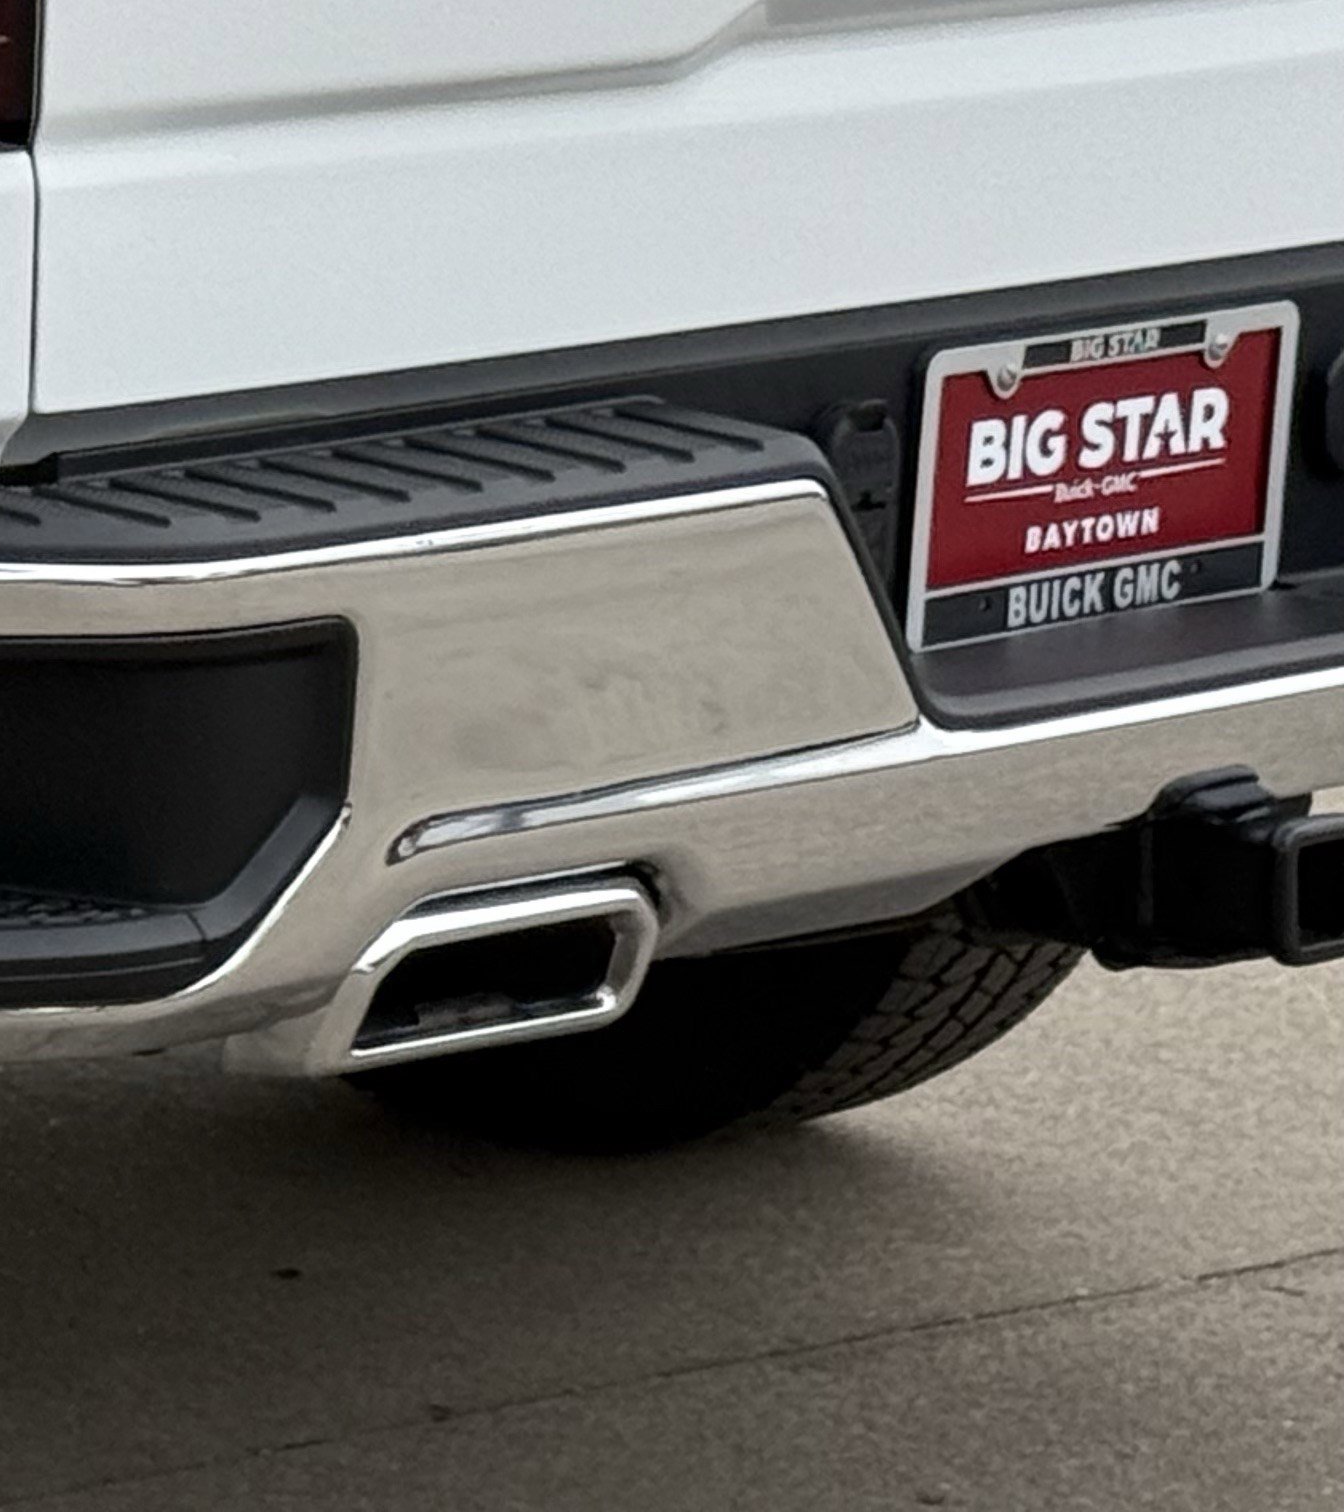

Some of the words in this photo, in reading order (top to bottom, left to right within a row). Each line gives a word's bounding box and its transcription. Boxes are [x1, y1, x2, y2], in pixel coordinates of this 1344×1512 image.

[1070, 337, 1107, 361] BIG
[1108, 328, 1161, 356] STAR
[966, 409, 1067, 487] BIG
[1077, 387, 1230, 468] STAR
[1024, 507, 1161, 554] BAYTOWN
[1006, 571, 1106, 630] BUICK
[1113, 560, 1182, 610] GMC
